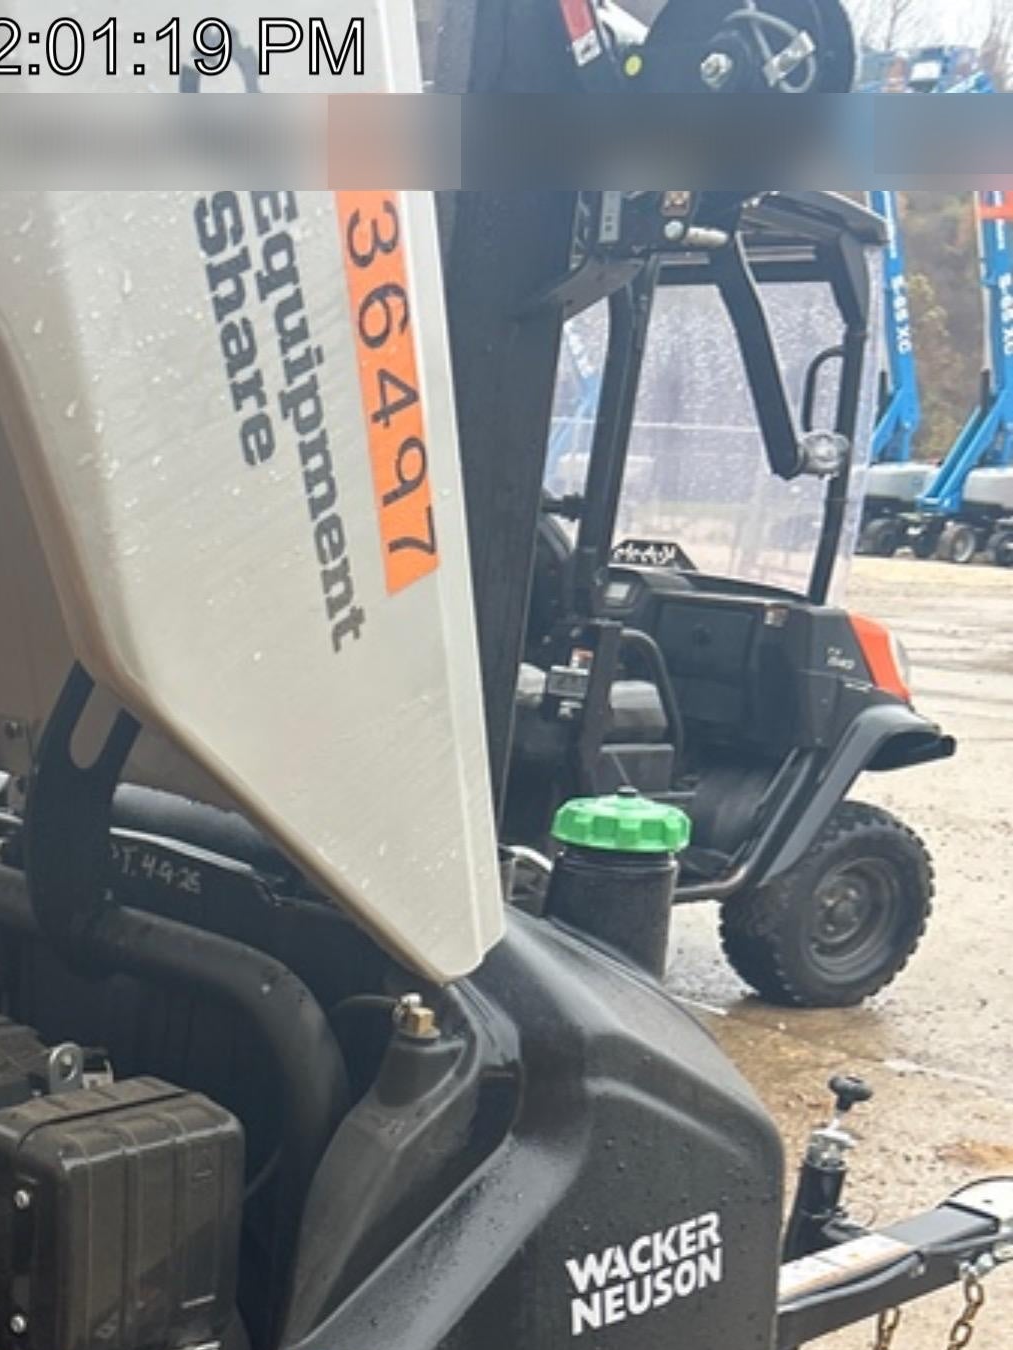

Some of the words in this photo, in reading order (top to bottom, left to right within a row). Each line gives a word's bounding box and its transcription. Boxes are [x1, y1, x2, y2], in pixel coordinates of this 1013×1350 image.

[193, 190, 278, 467] Share
[250, 190, 366, 653] Equipment
[564, 1210, 723, 1295] WACKER
[570, 1246, 724, 1337] NEUSON
